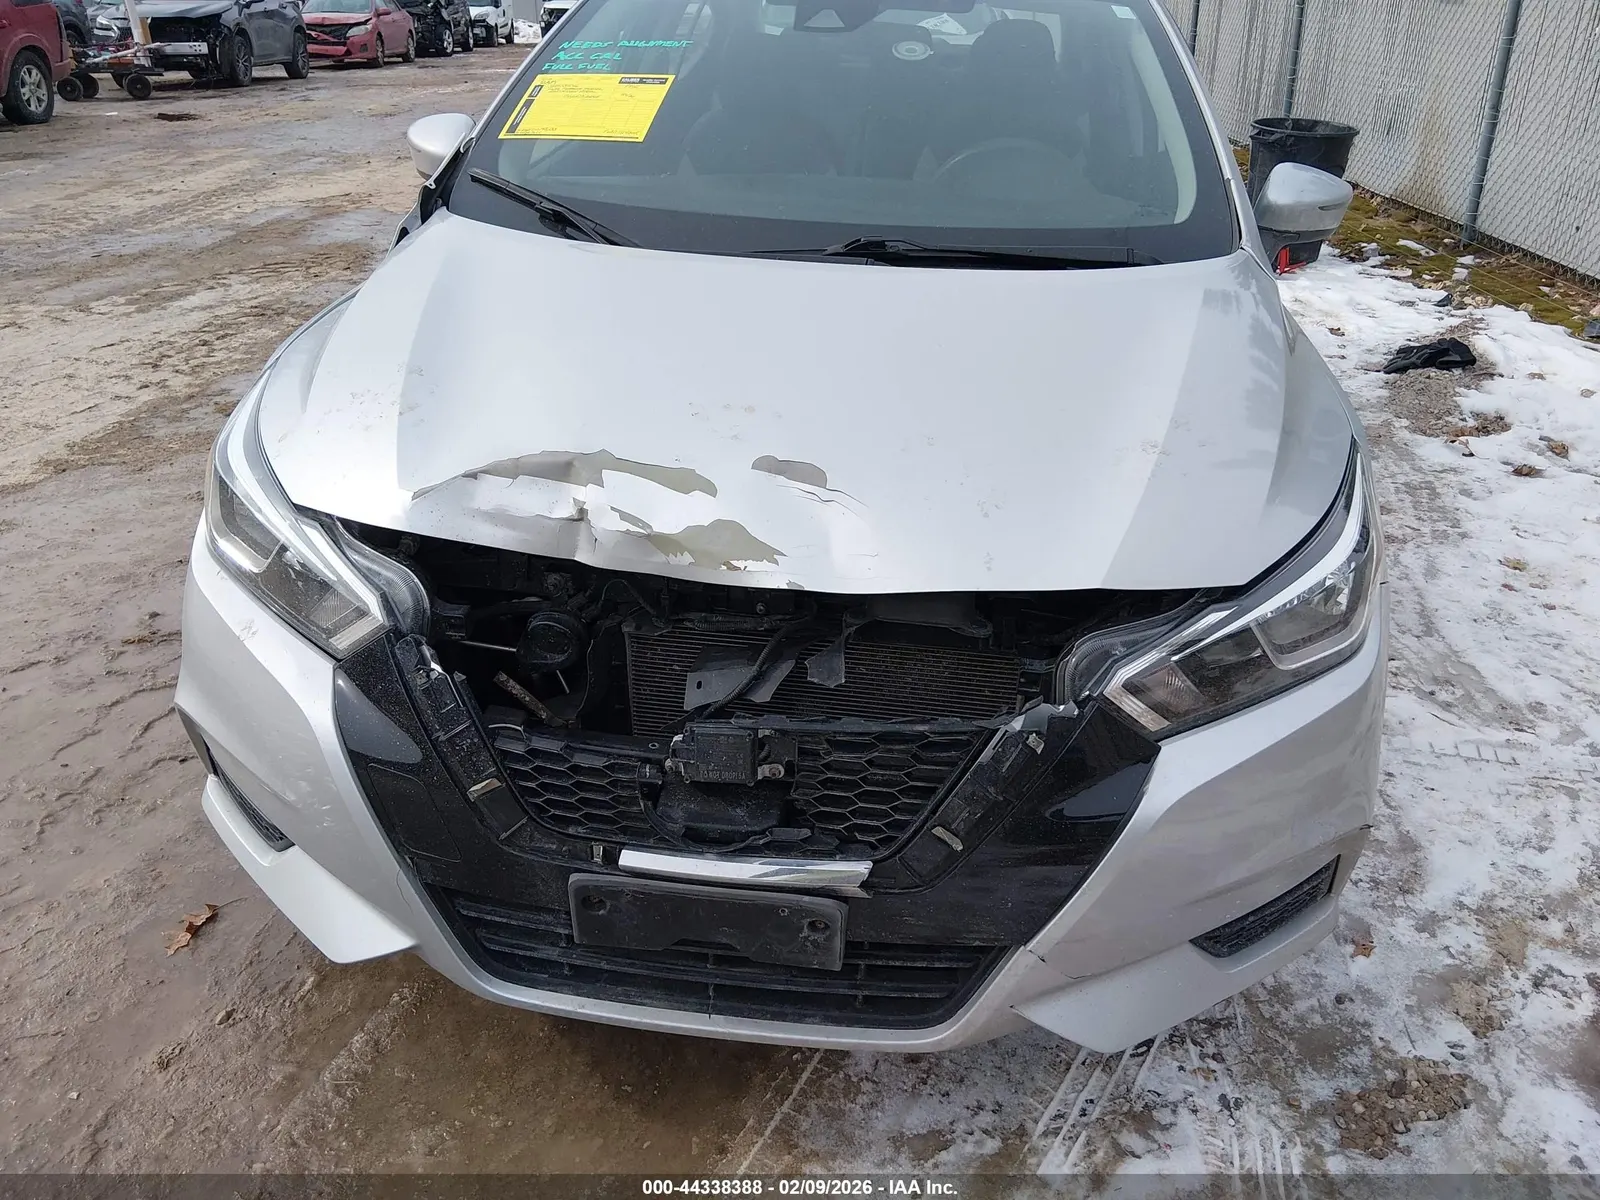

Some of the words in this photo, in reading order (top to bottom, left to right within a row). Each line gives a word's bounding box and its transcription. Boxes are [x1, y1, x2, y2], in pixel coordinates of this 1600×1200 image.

[557, 40, 614, 49] NEEDS
[590, 52, 622, 60] CAL
[542, 63, 573, 71] FULL
[578, 63, 610, 71] FUEL
